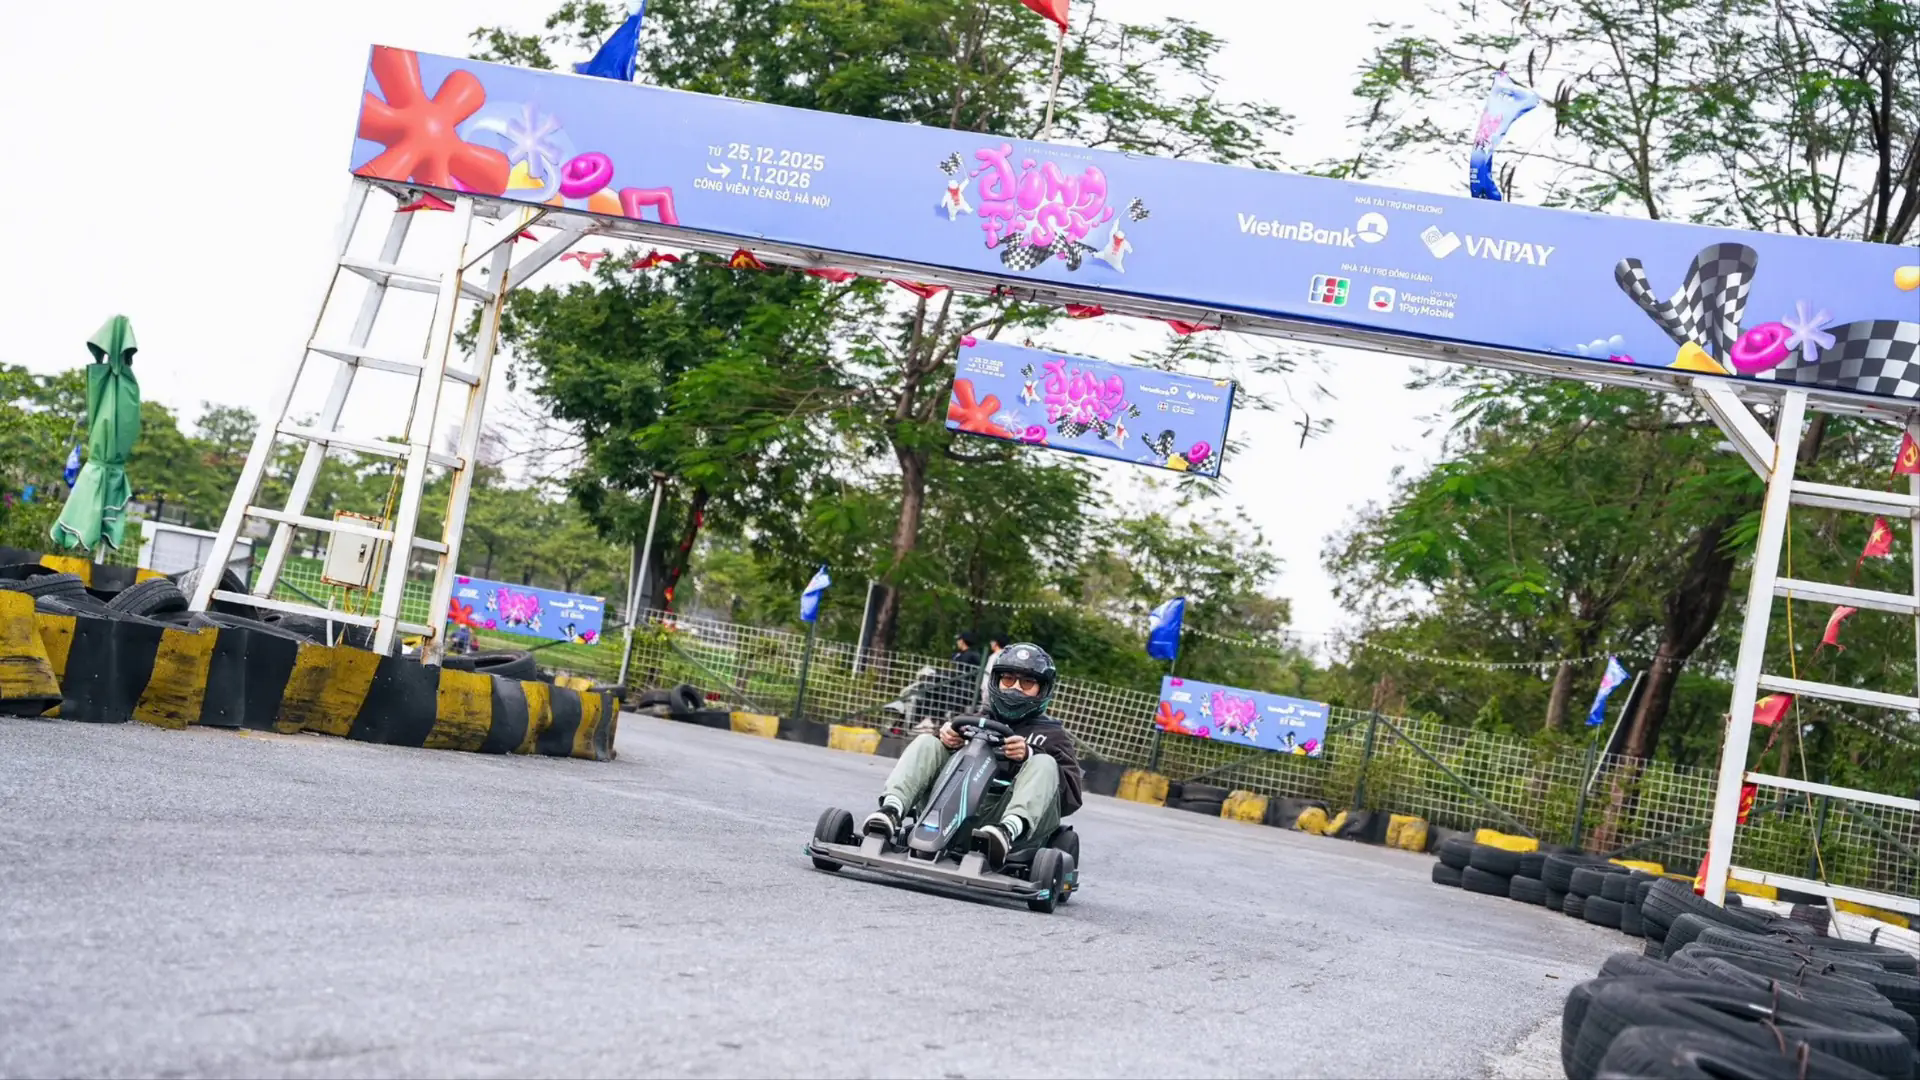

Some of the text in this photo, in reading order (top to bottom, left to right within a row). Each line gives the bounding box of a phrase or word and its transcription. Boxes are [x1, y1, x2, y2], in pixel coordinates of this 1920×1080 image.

[728, 142, 826, 171] 25.12.2025
[740, 163, 811, 188] 1.1.2026
[694, 178, 723, 192] CÔNG
[726, 182, 750, 196] VIÊN
[752, 185, 774, 199] YÊN
[795, 192, 809, 205] HÀ
[812, 195, 831, 208] NỘI
[1402, 202, 1416, 211] KIM
[1237, 213, 1357, 248] VietinBank
[1465, 234, 1556, 267] VNPAY
[1401, 292, 1456, 308] VietinBank
